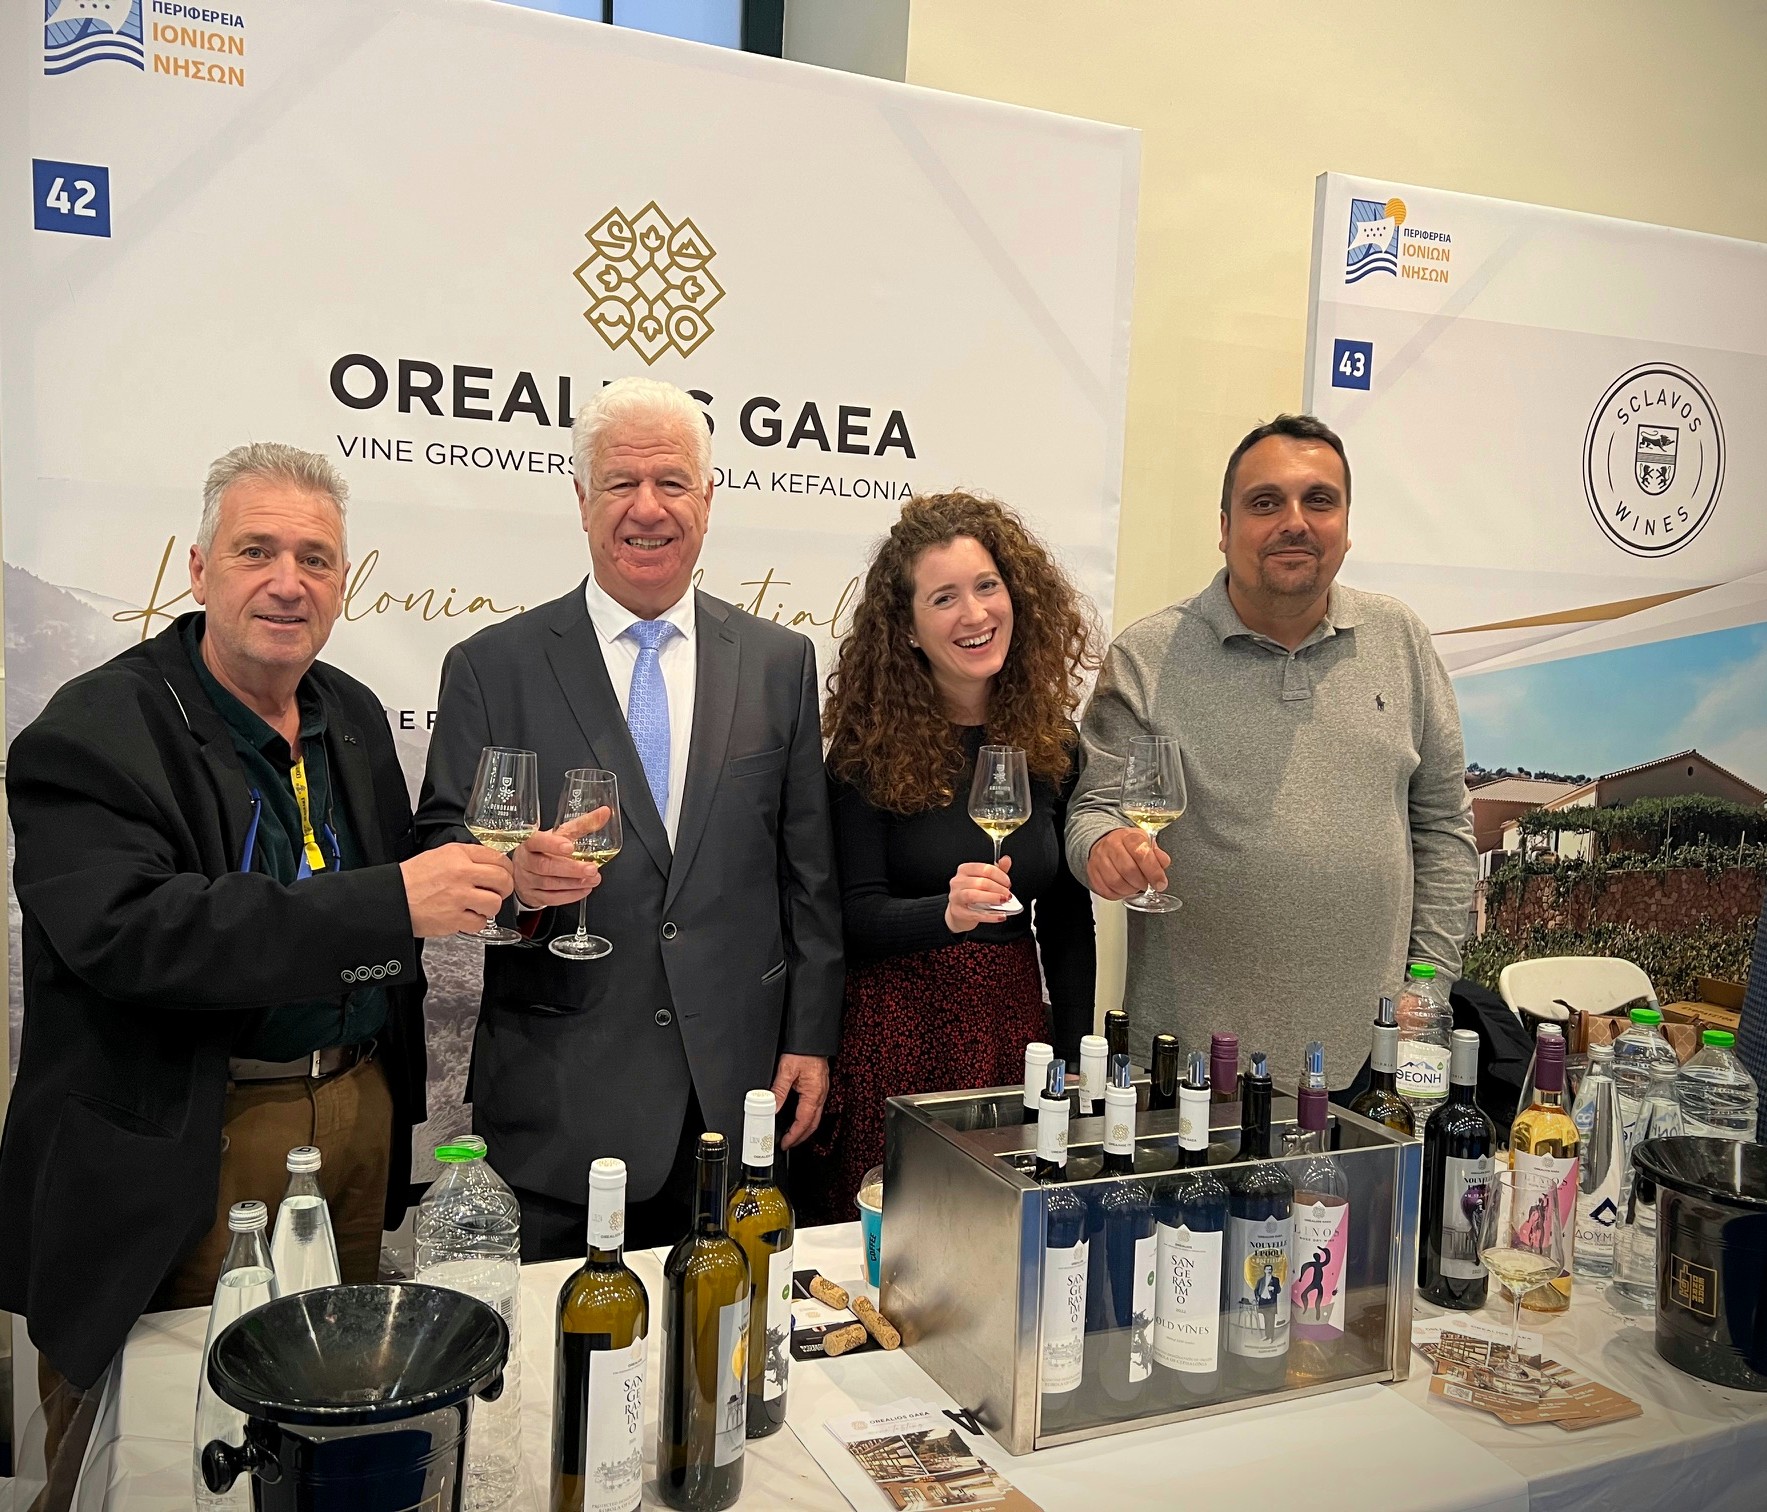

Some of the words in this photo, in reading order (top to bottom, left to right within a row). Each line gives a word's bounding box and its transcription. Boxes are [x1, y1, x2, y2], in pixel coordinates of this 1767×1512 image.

[152, 0, 245, 28] ΠΕΡΙΦΕΡΕΙΑ
[152, 22, 245, 56] ΙΟΝΙΩΝ
[153, 53, 245, 87] ΝΗΣΩΝ
[46, 177, 97, 217] 42
[1403, 228, 1452, 243] ΠΕΡΙΦΕΡΕΙΑ
[1402, 243, 1451, 262] ΙΟΝΙΩΝ
[1401, 264, 1449, 283] ΝΗΣΩΝ
[1339, 350, 1366, 378] 43
[330, 353, 716, 436] OREALS
[739, 396, 917, 459] GAEA
[1617, 388, 1701, 433] SCLAVOS
[336, 434, 414, 462] VINE
[771, 472, 915, 501] KEFALONIA
[1615, 500, 1689, 536] WINES
[1396, 1068, 1442, 1084] ΘΕΟΝΗ
[1575, 1229, 1612, 1243] ΔΟΥΜ
[1170, 1254, 1195, 1268] SAN
[1172, 1276, 1192, 1288] RAS
[1174, 1266, 1191, 1279] GE
[1176, 1296, 1186, 1305] O
[1155, 1316, 1175, 1330] OLD
[1177, 1323, 1210, 1335] VINES
